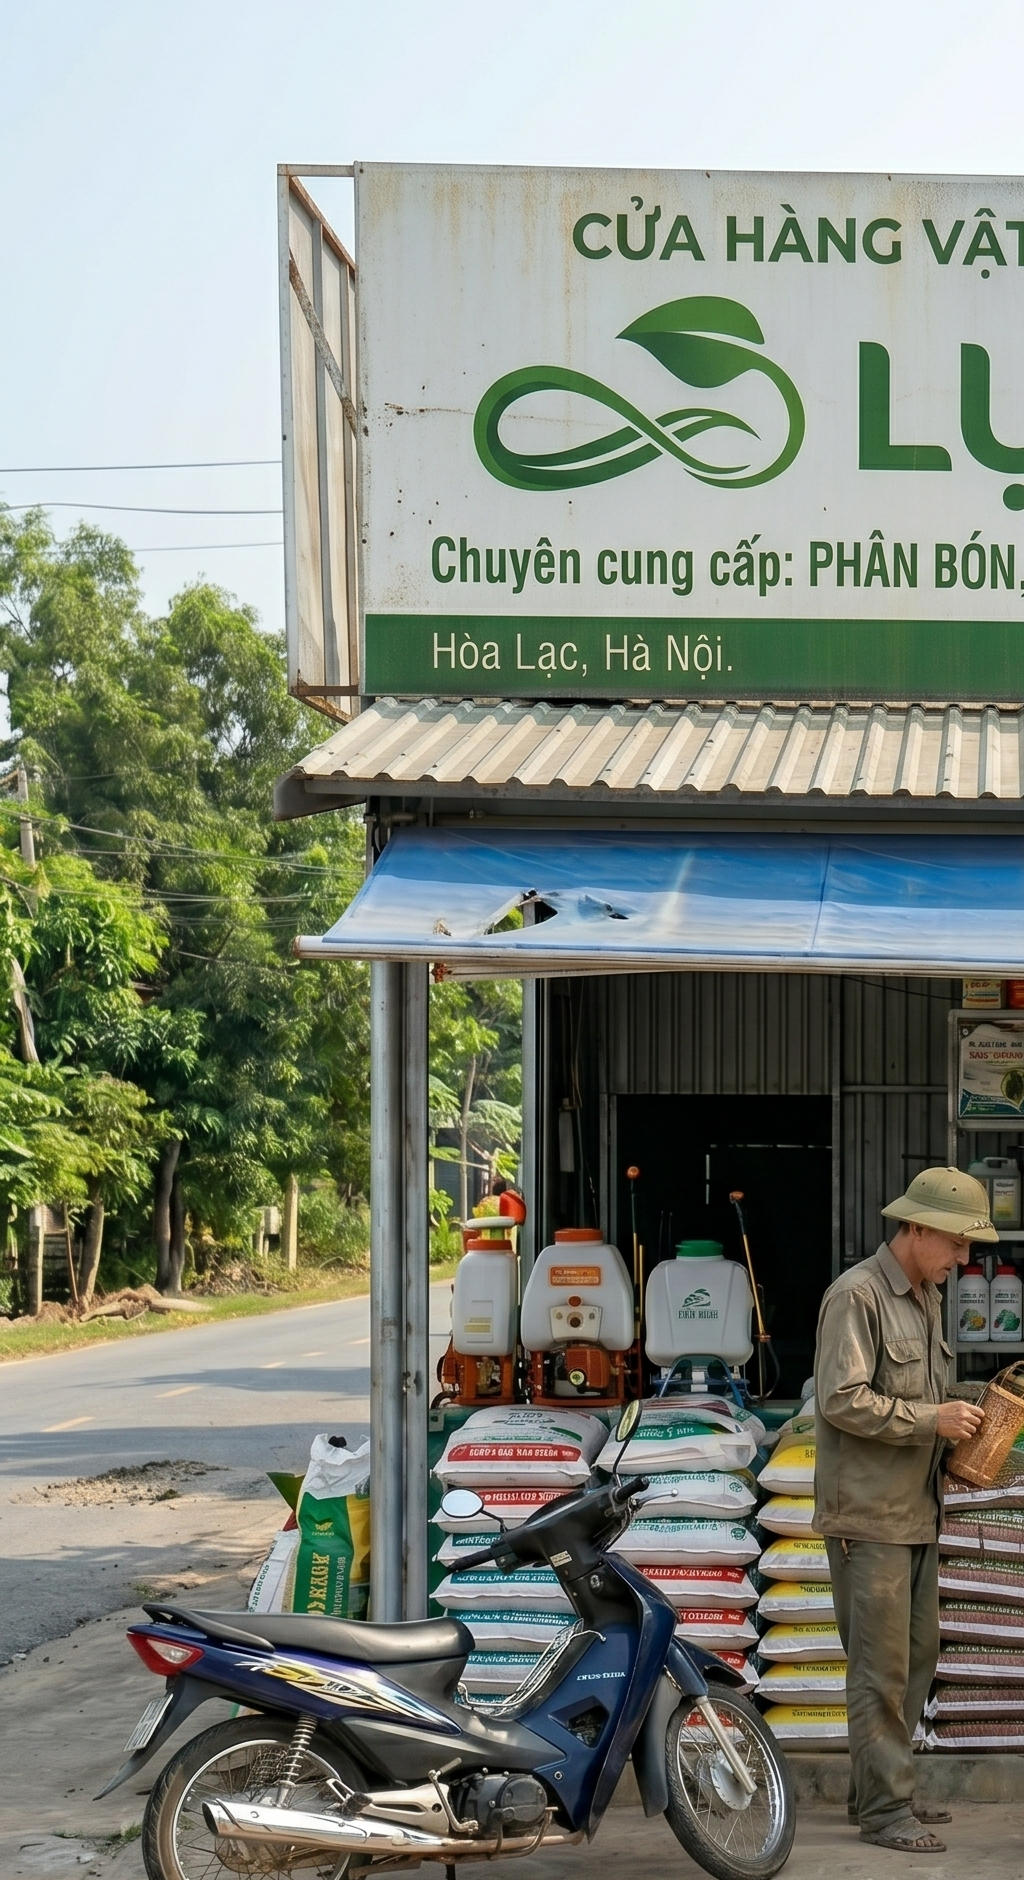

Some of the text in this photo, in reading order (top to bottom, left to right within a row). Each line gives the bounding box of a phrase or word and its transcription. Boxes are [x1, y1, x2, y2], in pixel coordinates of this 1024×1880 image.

[573, 196, 705, 260] CỬA
[726, 204, 903, 265] HÀNG
[431, 536, 581, 594] Chuyên
[597, 548, 694, 597] cung
[709, 534, 794, 597] cấp:
[809, 530, 918, 589] PHÂN
[433, 632, 733, 680] Hòa Lạc, Hà Nội.
